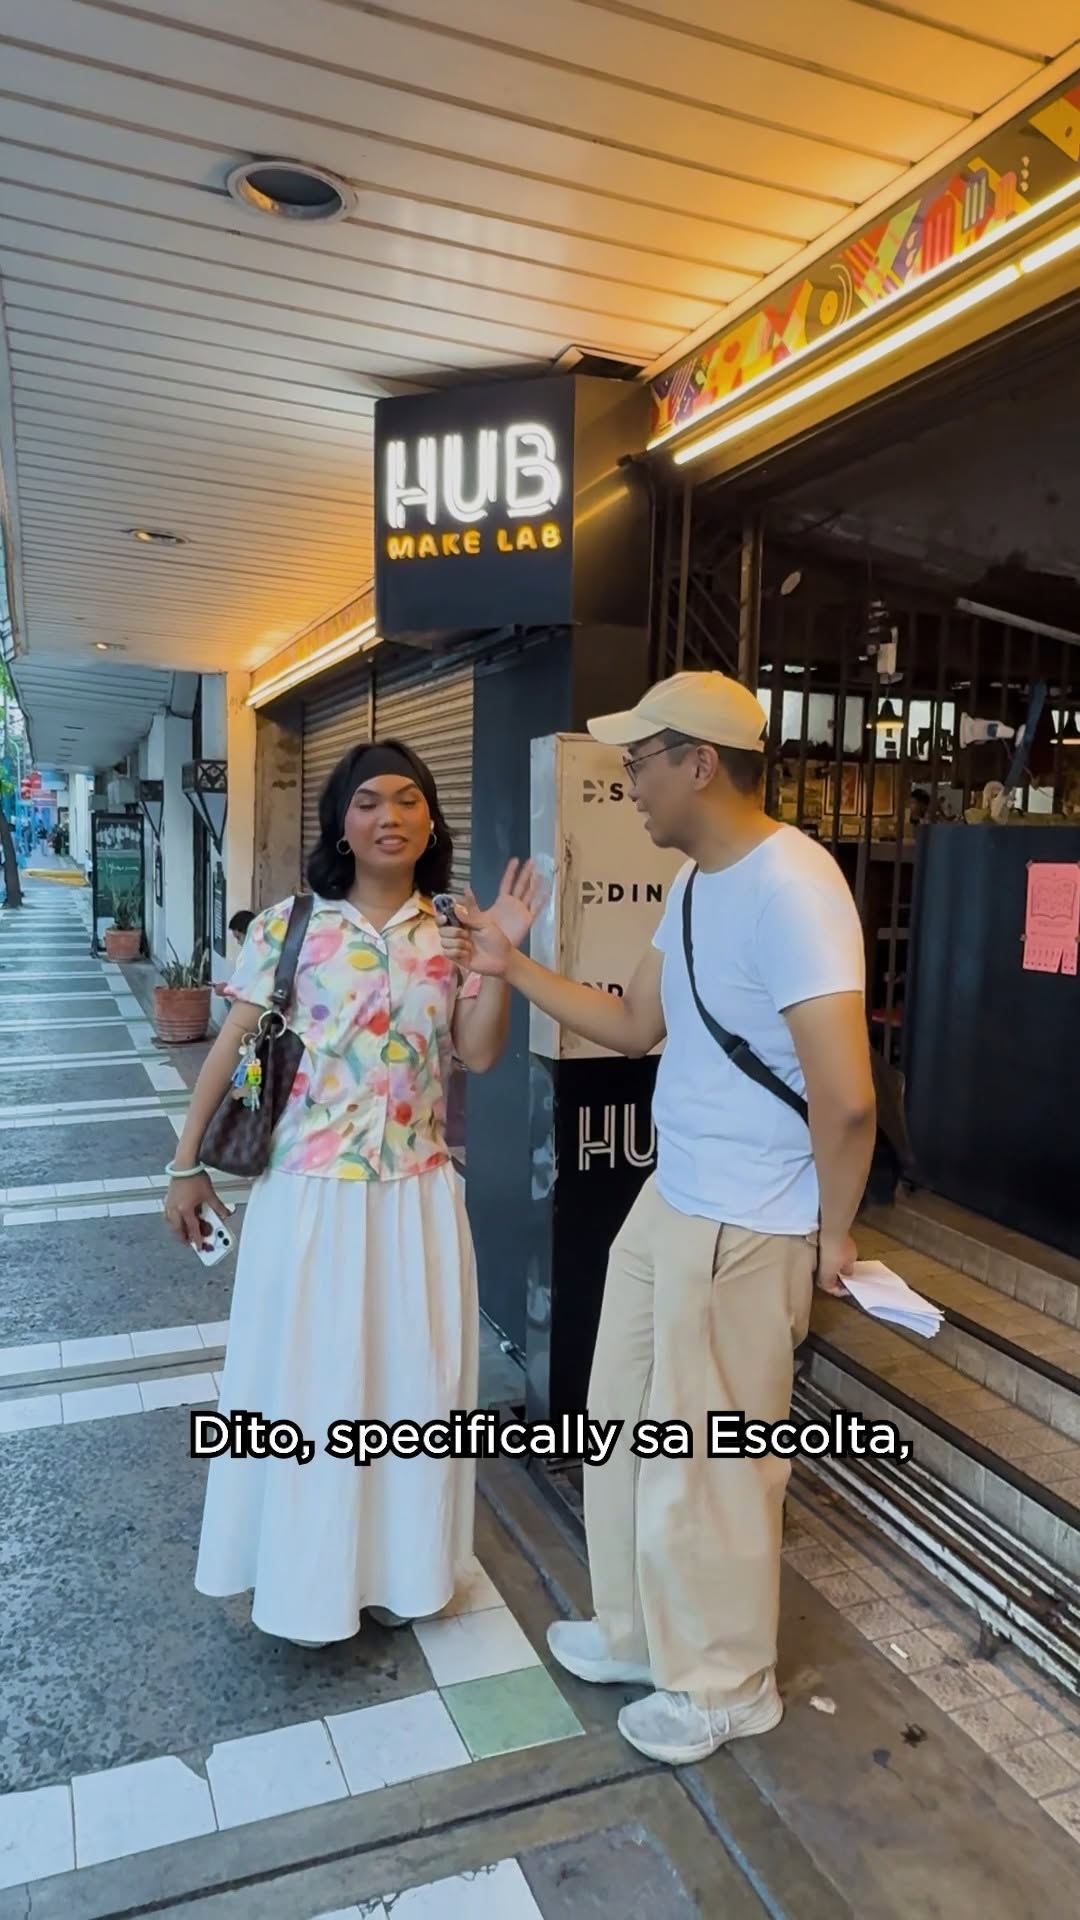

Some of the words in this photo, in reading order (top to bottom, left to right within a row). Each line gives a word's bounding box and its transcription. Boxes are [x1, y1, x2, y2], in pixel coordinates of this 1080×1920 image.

[386, 422, 562, 529] HUB
[387, 530, 481, 560] MAKE
[497, 523, 562, 551] LAB
